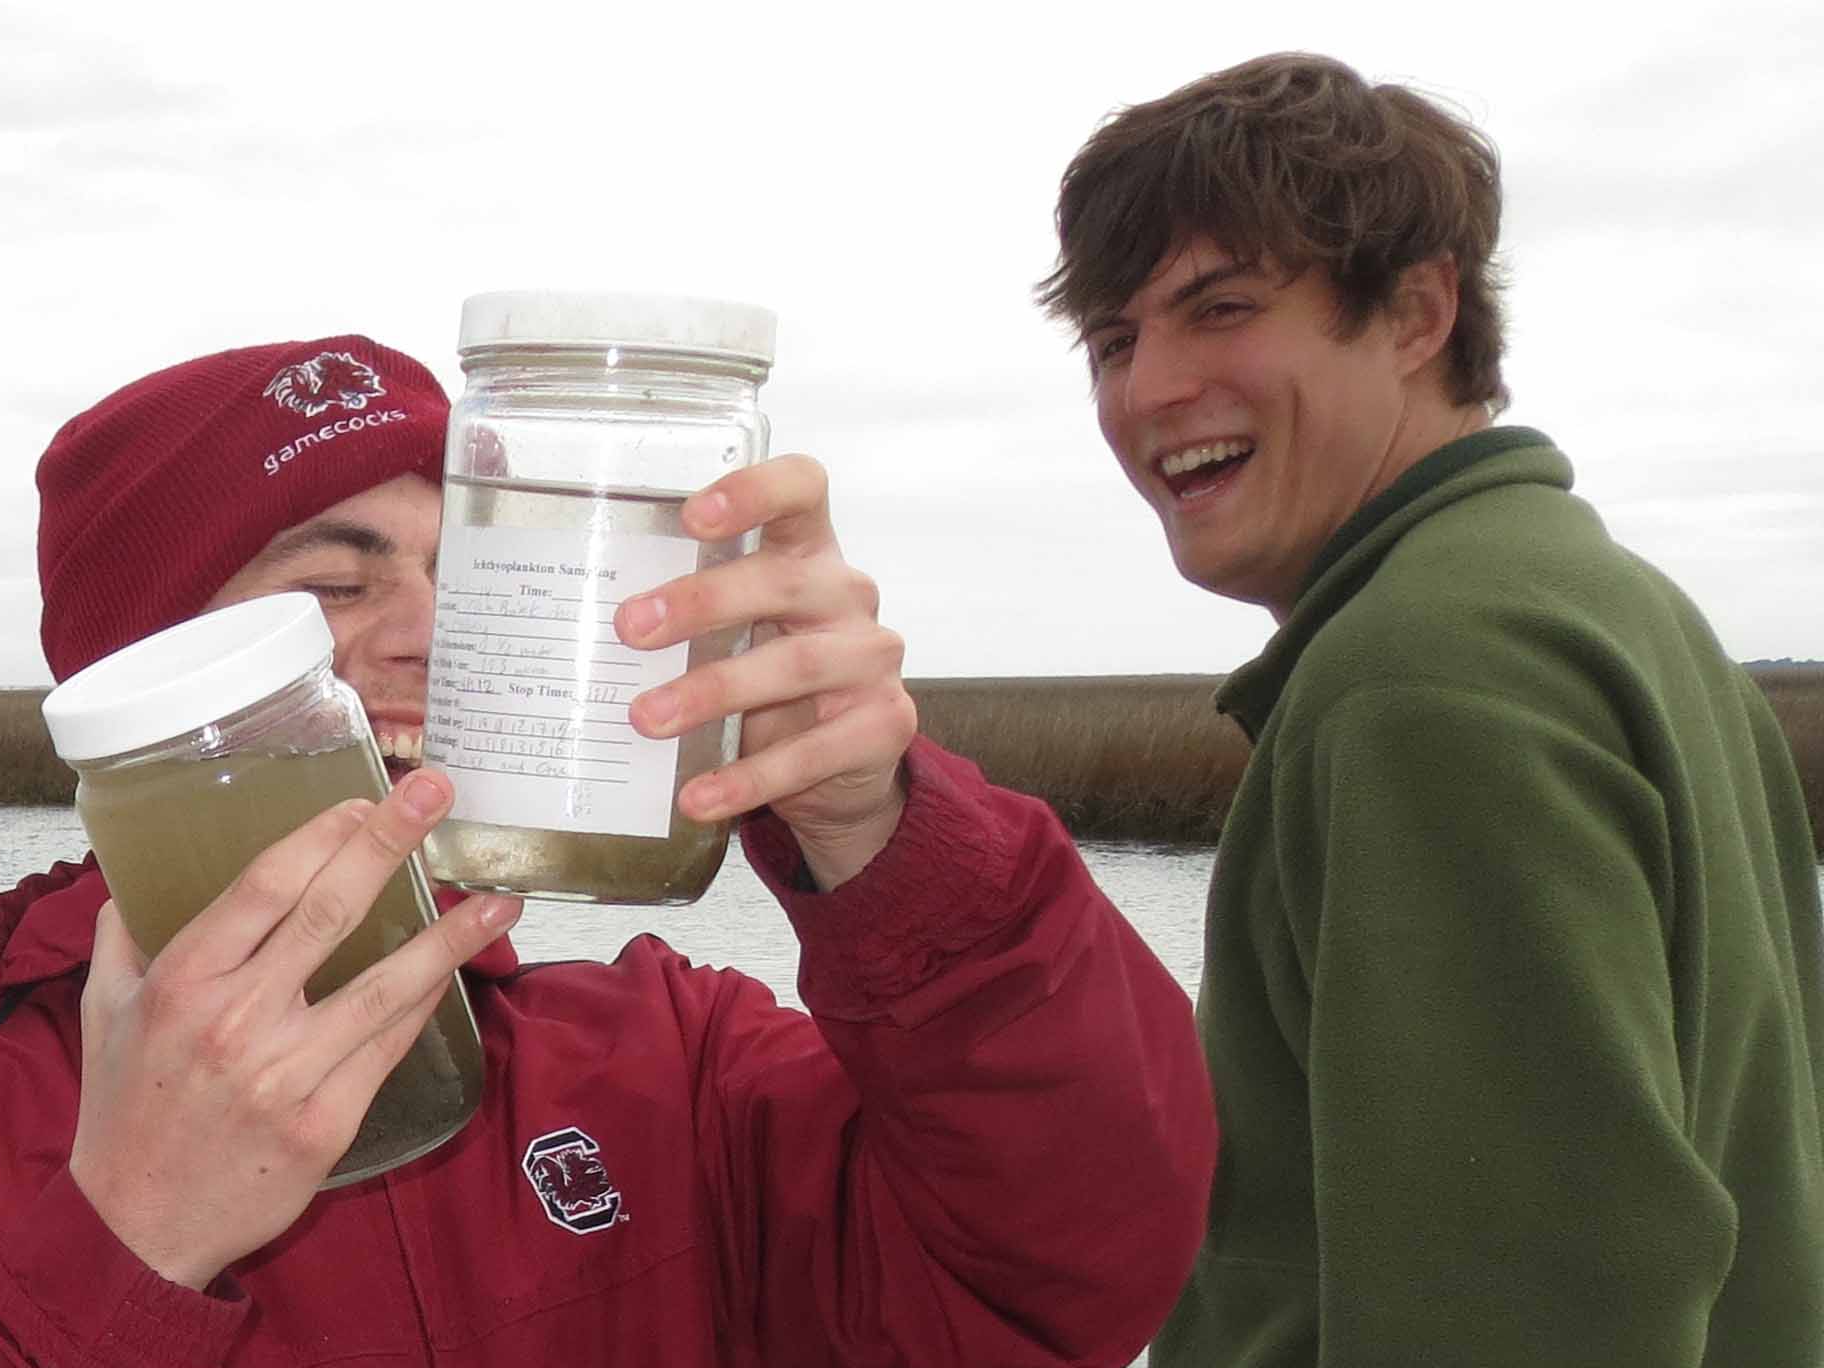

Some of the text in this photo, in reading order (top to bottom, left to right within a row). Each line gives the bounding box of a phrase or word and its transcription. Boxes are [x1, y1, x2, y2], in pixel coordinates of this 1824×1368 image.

[264, 409, 407, 476] gamecocks
[519, 584, 553, 598] Time:
[509, 682, 574, 699] Stop Time:
